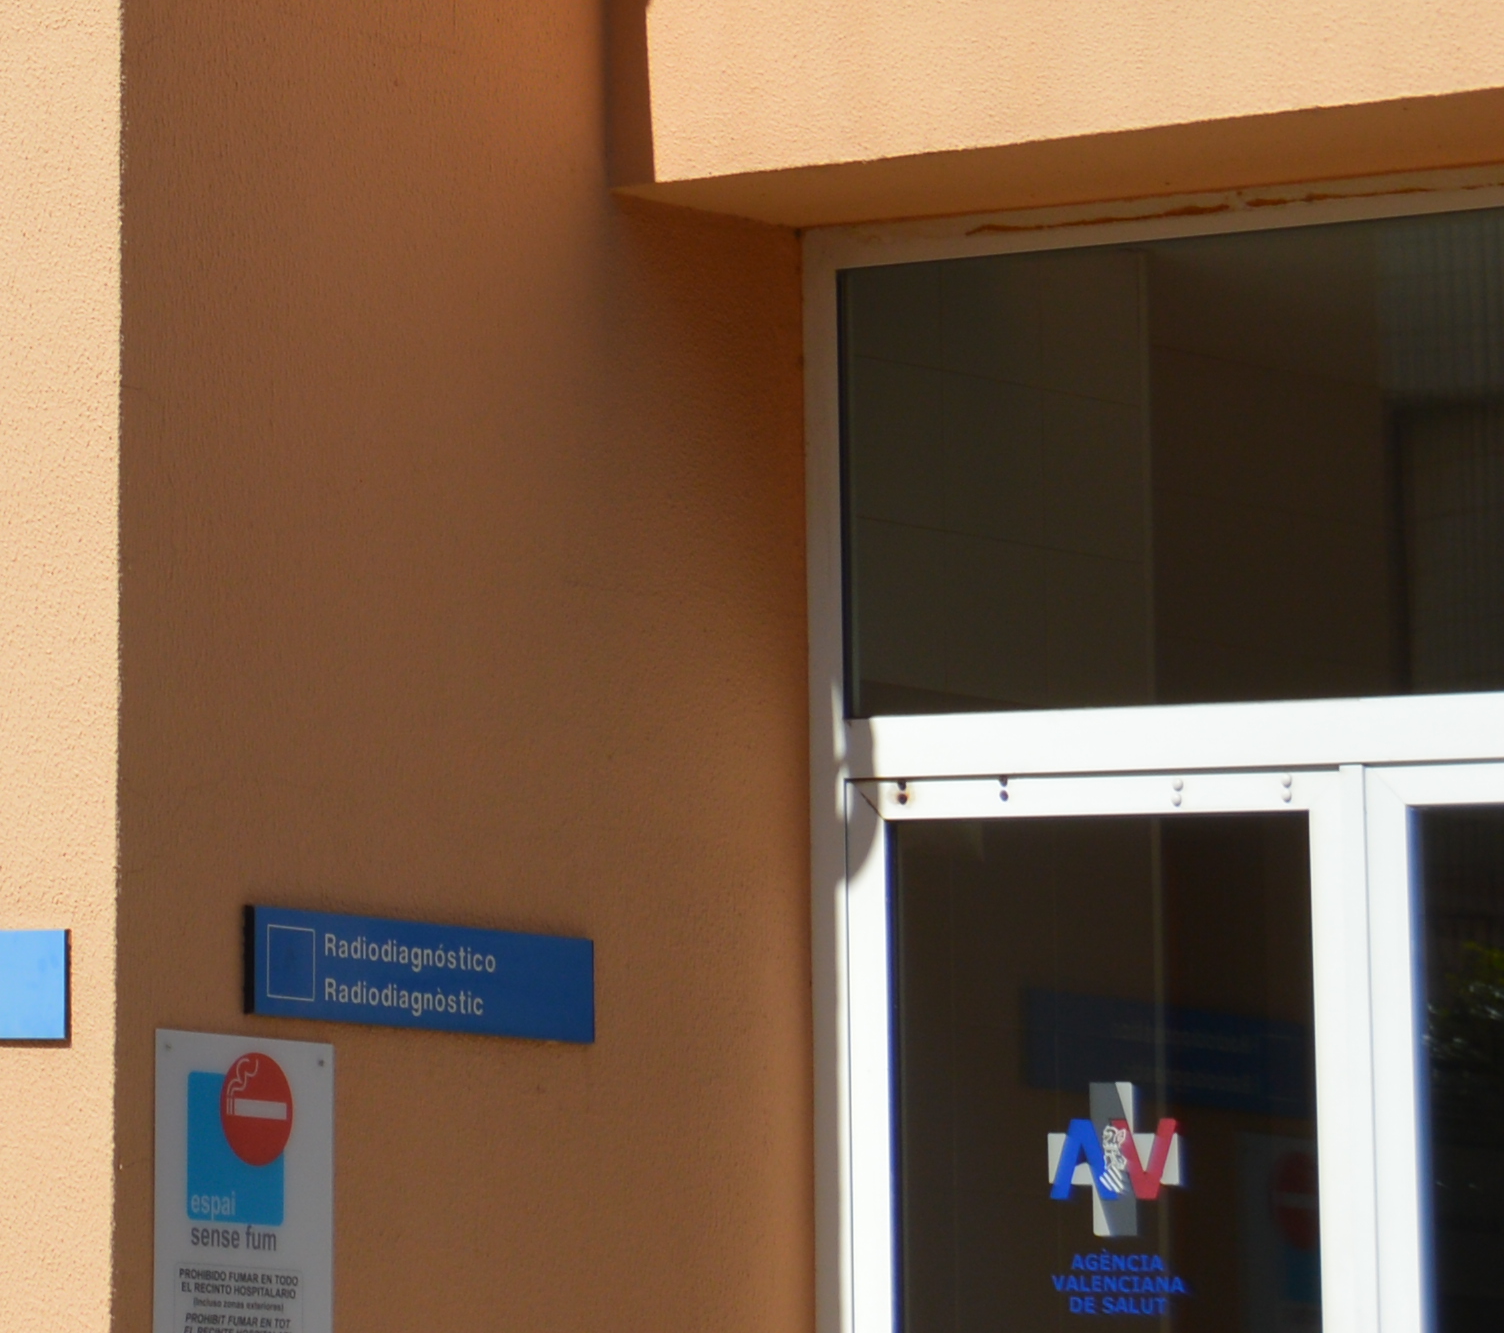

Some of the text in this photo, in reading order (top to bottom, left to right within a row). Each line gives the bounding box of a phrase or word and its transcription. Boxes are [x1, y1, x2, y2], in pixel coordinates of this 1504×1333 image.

[324, 933, 496, 973] Radiodiagnóstico
[324, 978, 484, 1017] Radiodiagnòstic
[191, 1191, 236, 1221] espai
[191, 1225, 276, 1251] sense fum
[1071, 1249, 1164, 1272] AGÈNCIA
[179, 1268, 299, 1287] PROHIBIDO FUMAR EN TODO
[1052, 1275, 1186, 1294] VALENCIANA
[181, 1281, 297, 1299] EL RECINTO HOSPITALARIO
[1069, 1297, 1168, 1315] DE SALUT
[185, 1312, 291, 1329] PROHIBIT FUMAR EN TOT
